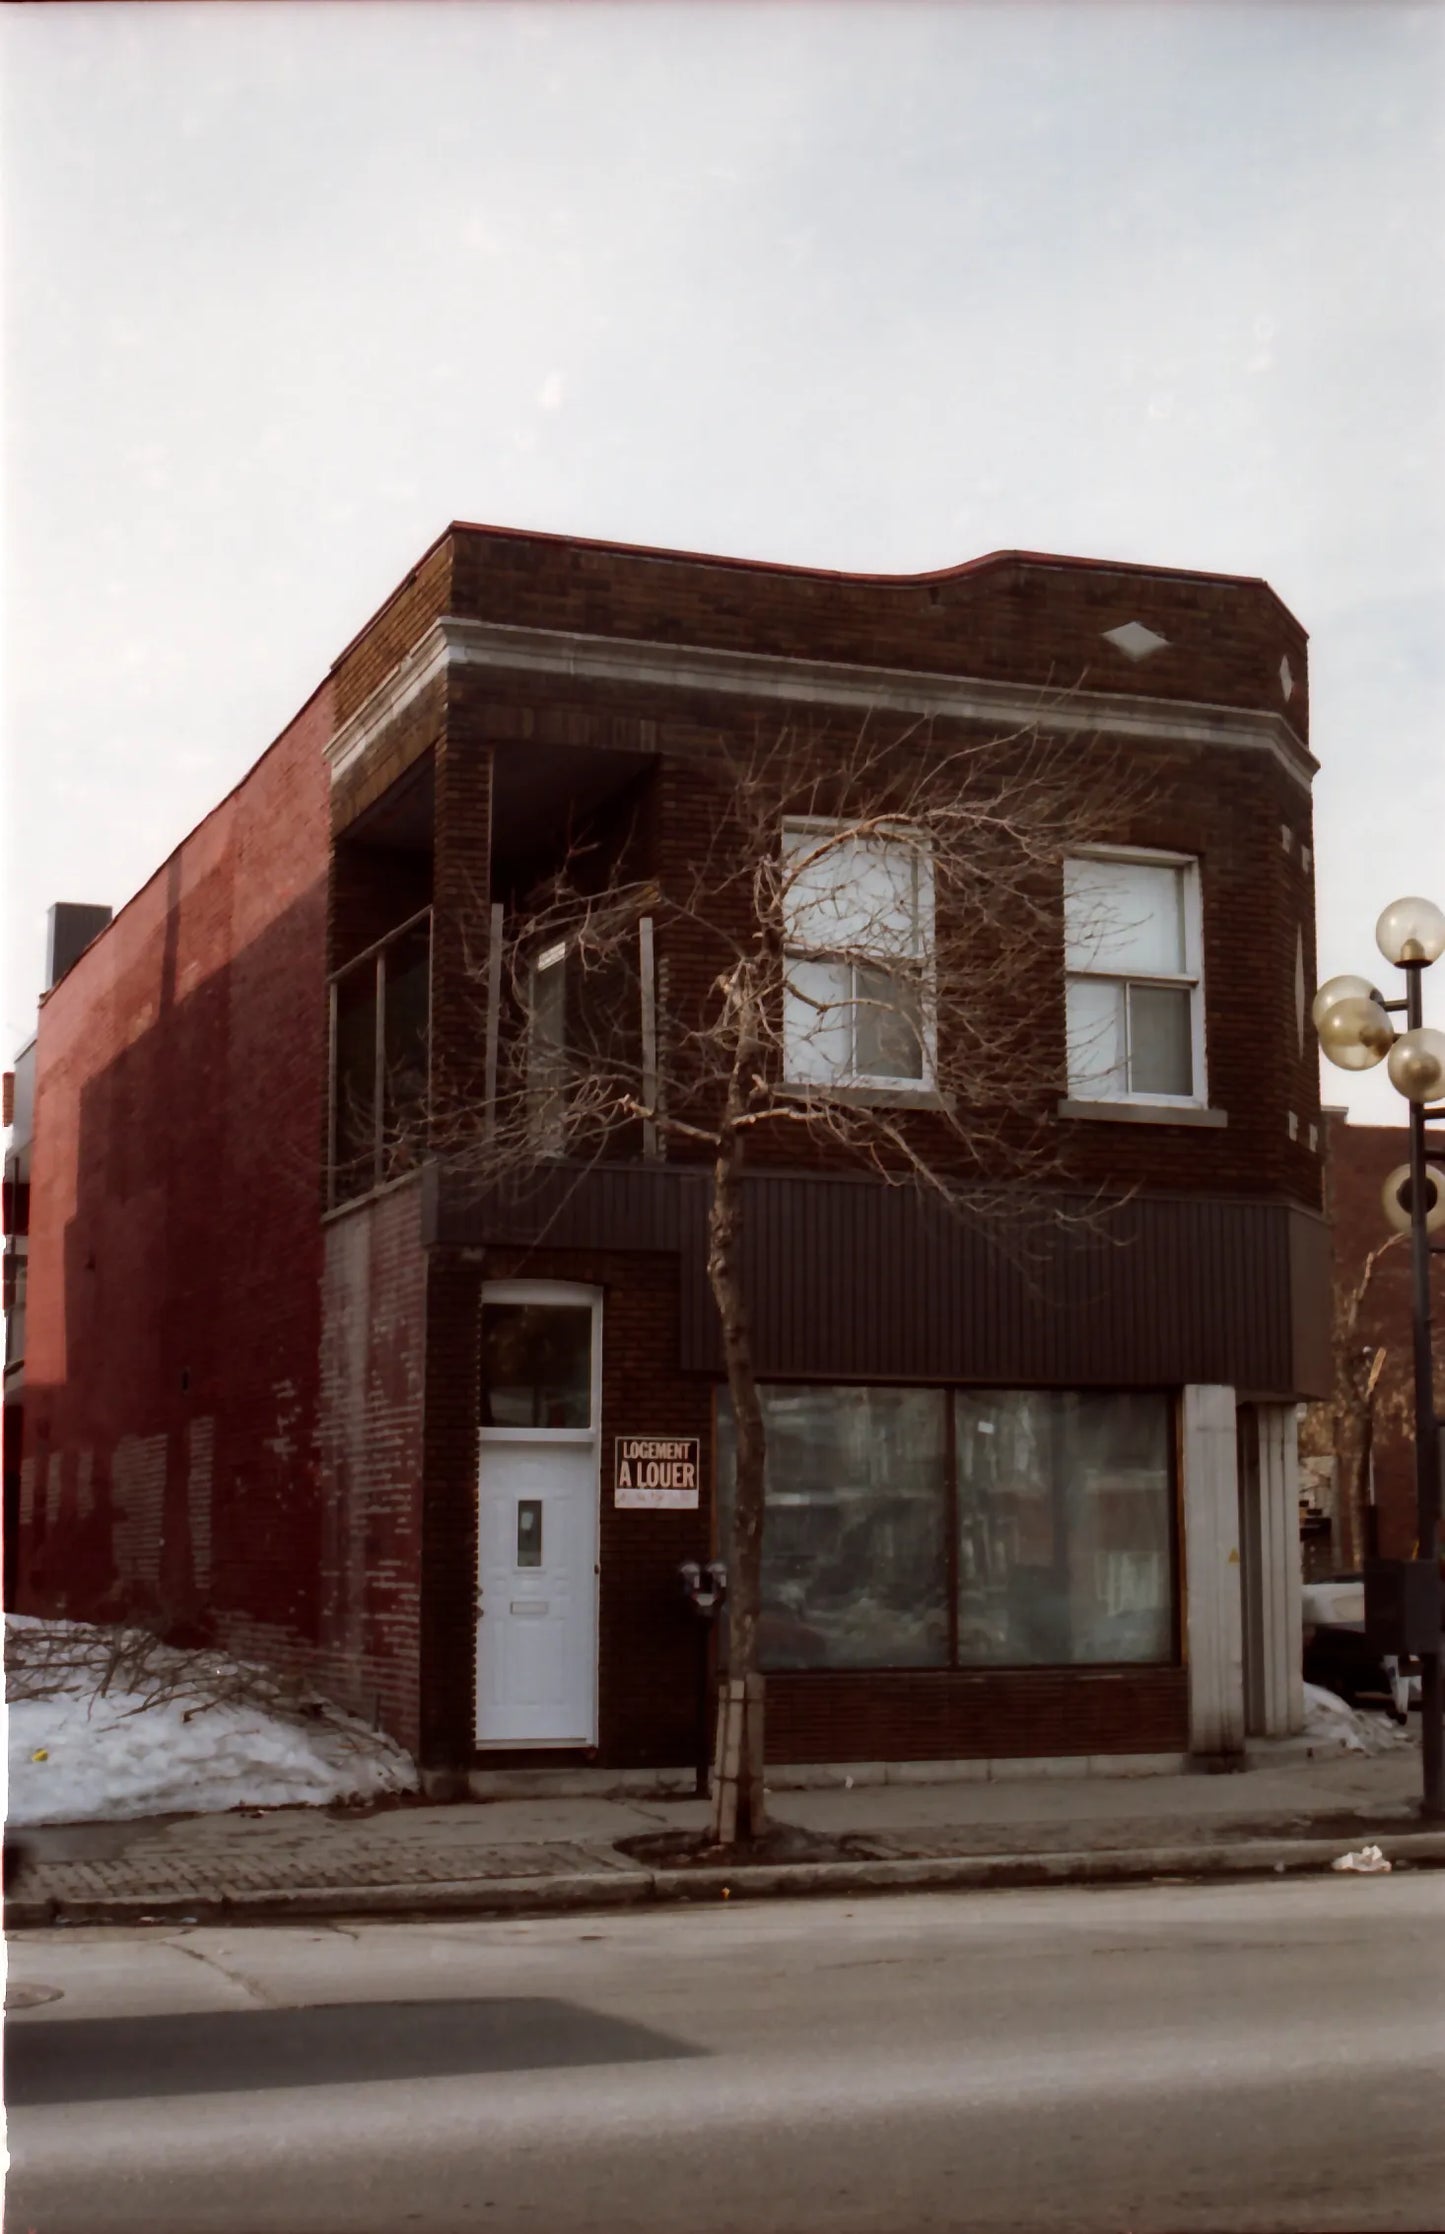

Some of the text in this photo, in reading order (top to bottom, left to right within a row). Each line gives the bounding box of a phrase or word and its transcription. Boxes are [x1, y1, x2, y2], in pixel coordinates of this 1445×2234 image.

[623, 1441, 691, 1459] LOGEMENT
[619, 1460, 695, 1488] A LOUER
